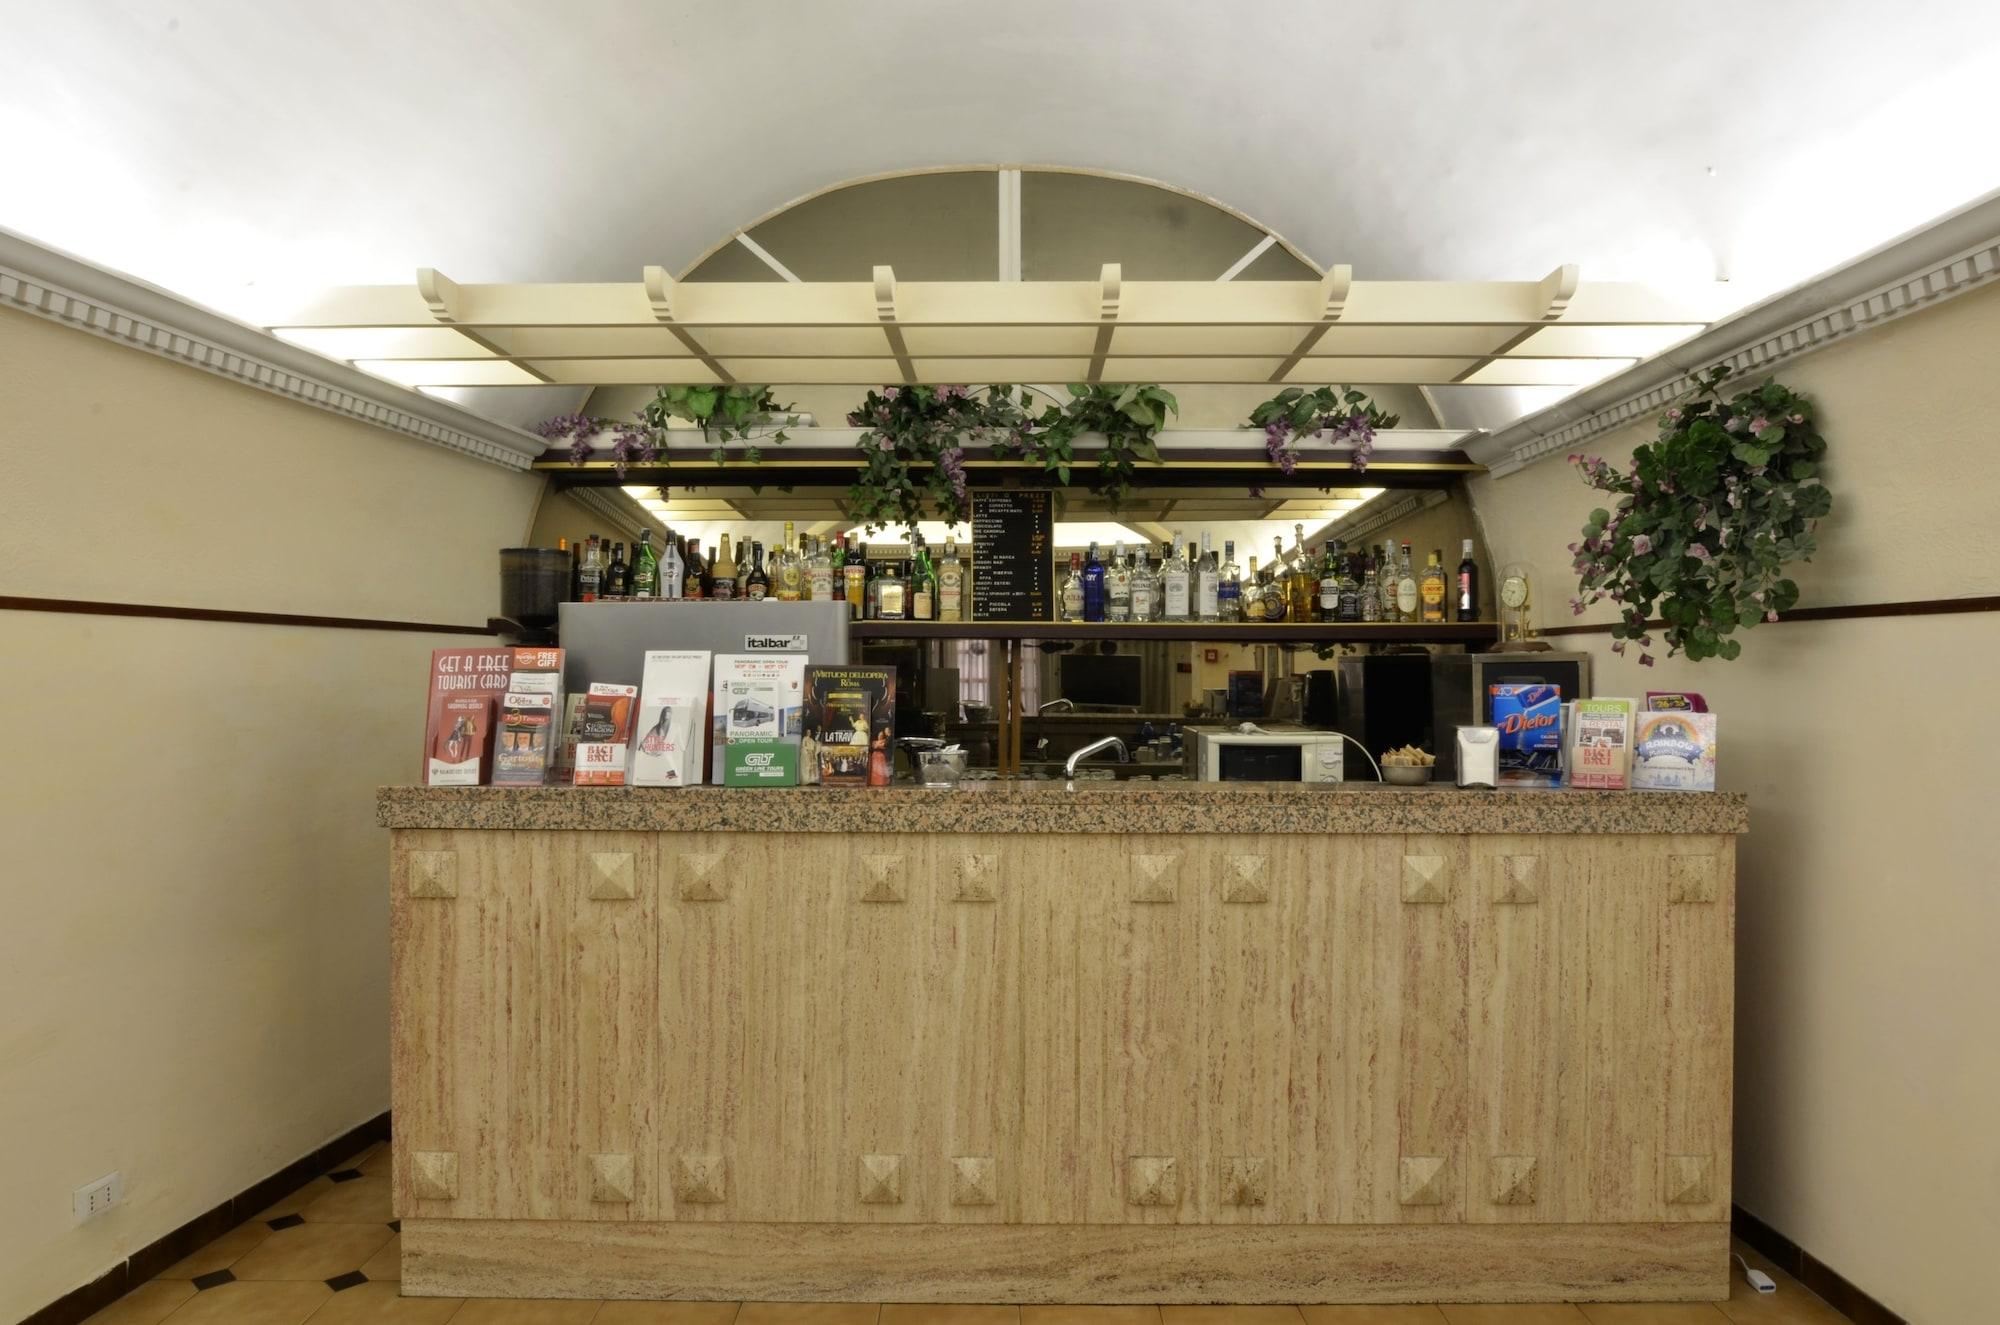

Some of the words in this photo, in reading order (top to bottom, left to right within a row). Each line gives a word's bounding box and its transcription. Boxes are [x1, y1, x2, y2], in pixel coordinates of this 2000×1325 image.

[748, 636, 791, 648] italbar
[438, 655, 461, 672] GET
[464, 655, 474, 672] A
[476, 654, 510, 672] FREE
[537, 652, 558, 660] FREE
[438, 674, 478, 690] TOURIST
[480, 674, 508, 688] CARD
[1505, 713, 1557, 734] Dietor
[825, 732, 834, 742] LA
